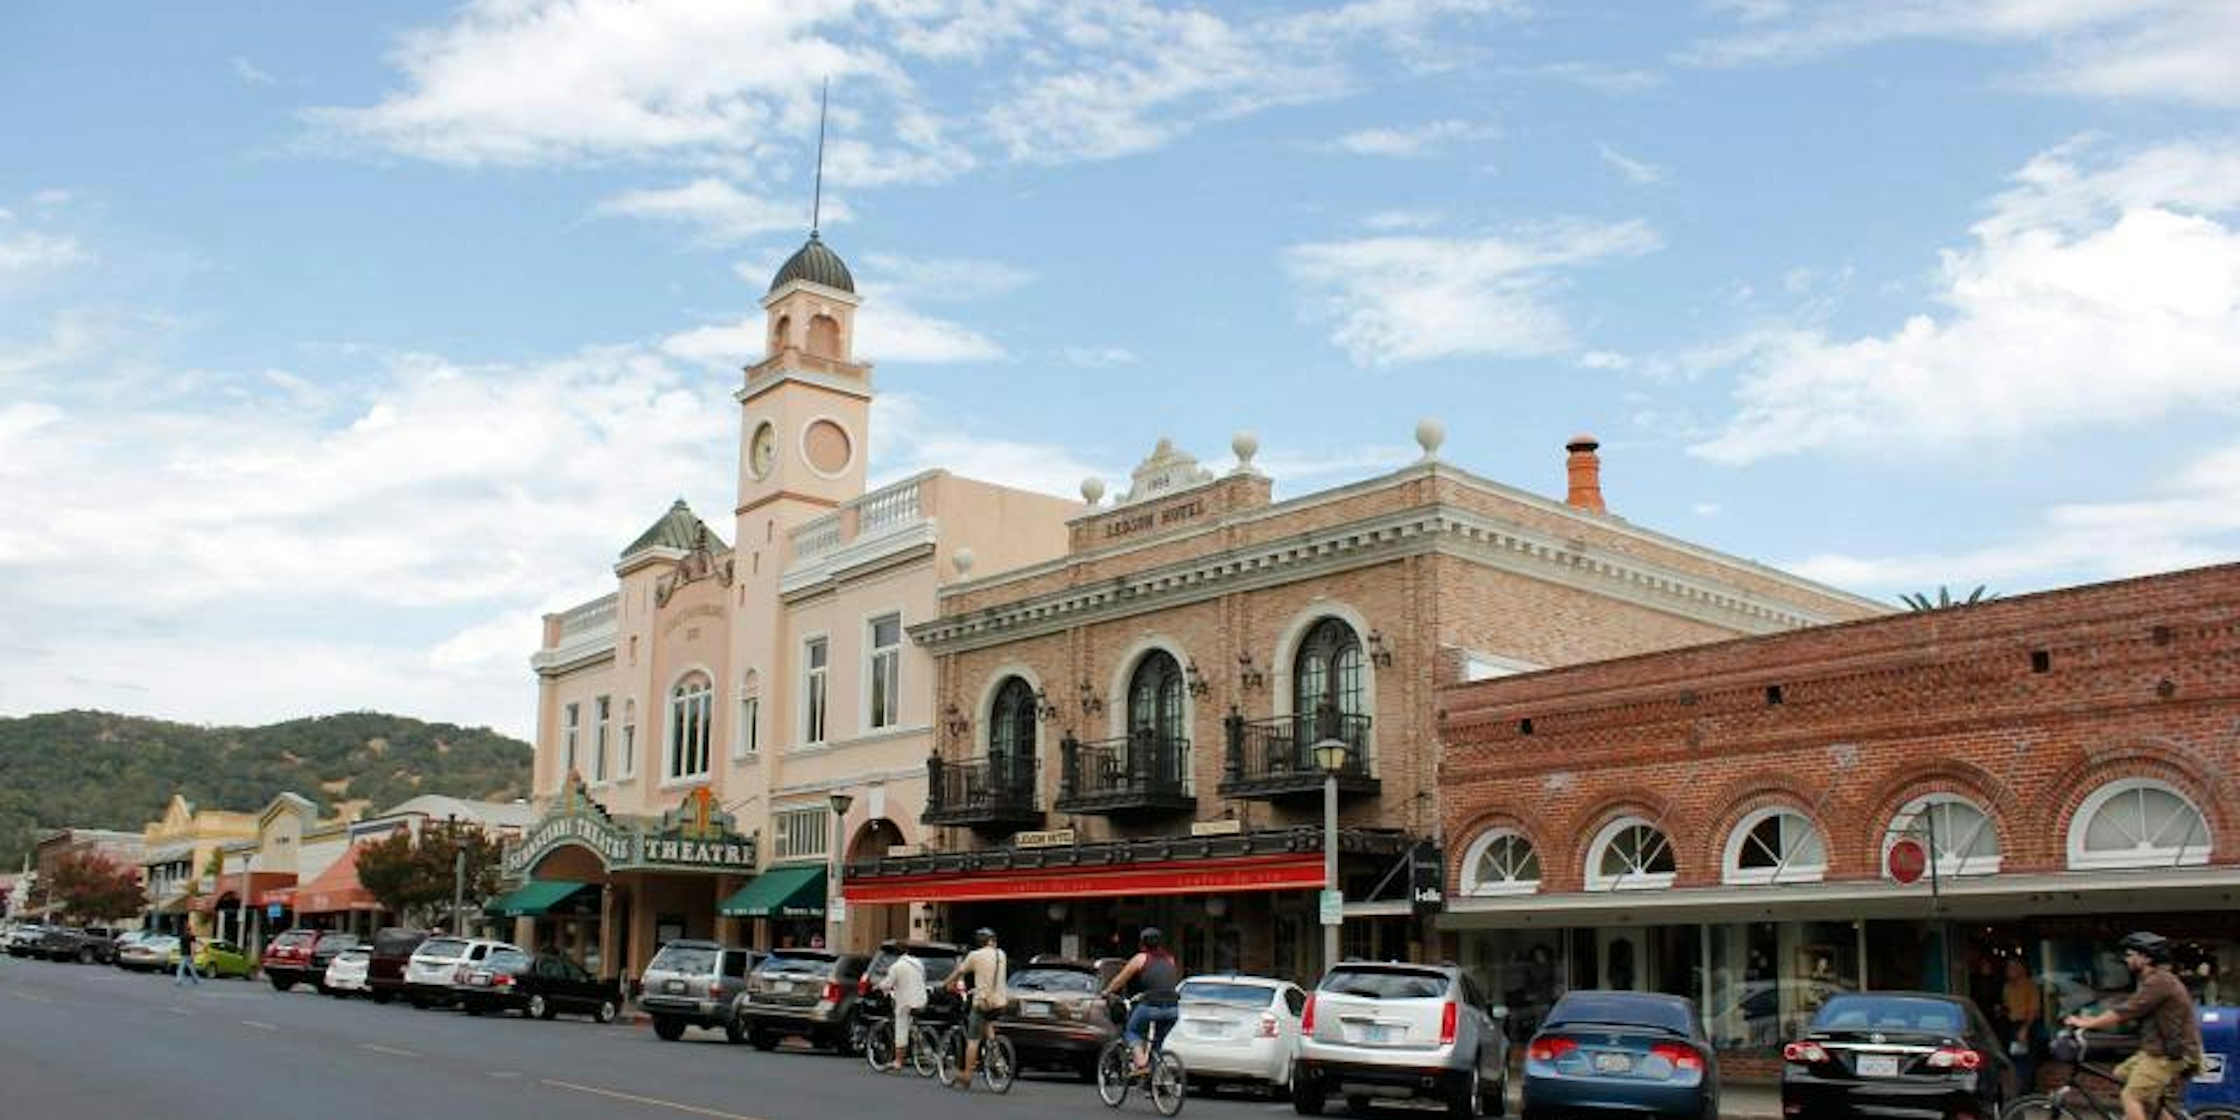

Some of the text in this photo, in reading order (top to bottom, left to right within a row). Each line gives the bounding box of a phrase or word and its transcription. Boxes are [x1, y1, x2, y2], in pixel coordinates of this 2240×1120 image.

[1103, 499, 1204, 538] LEDSON HOTEL
[577, 817, 629, 860] THEATRE
[643, 840, 756, 865] THEATRE
